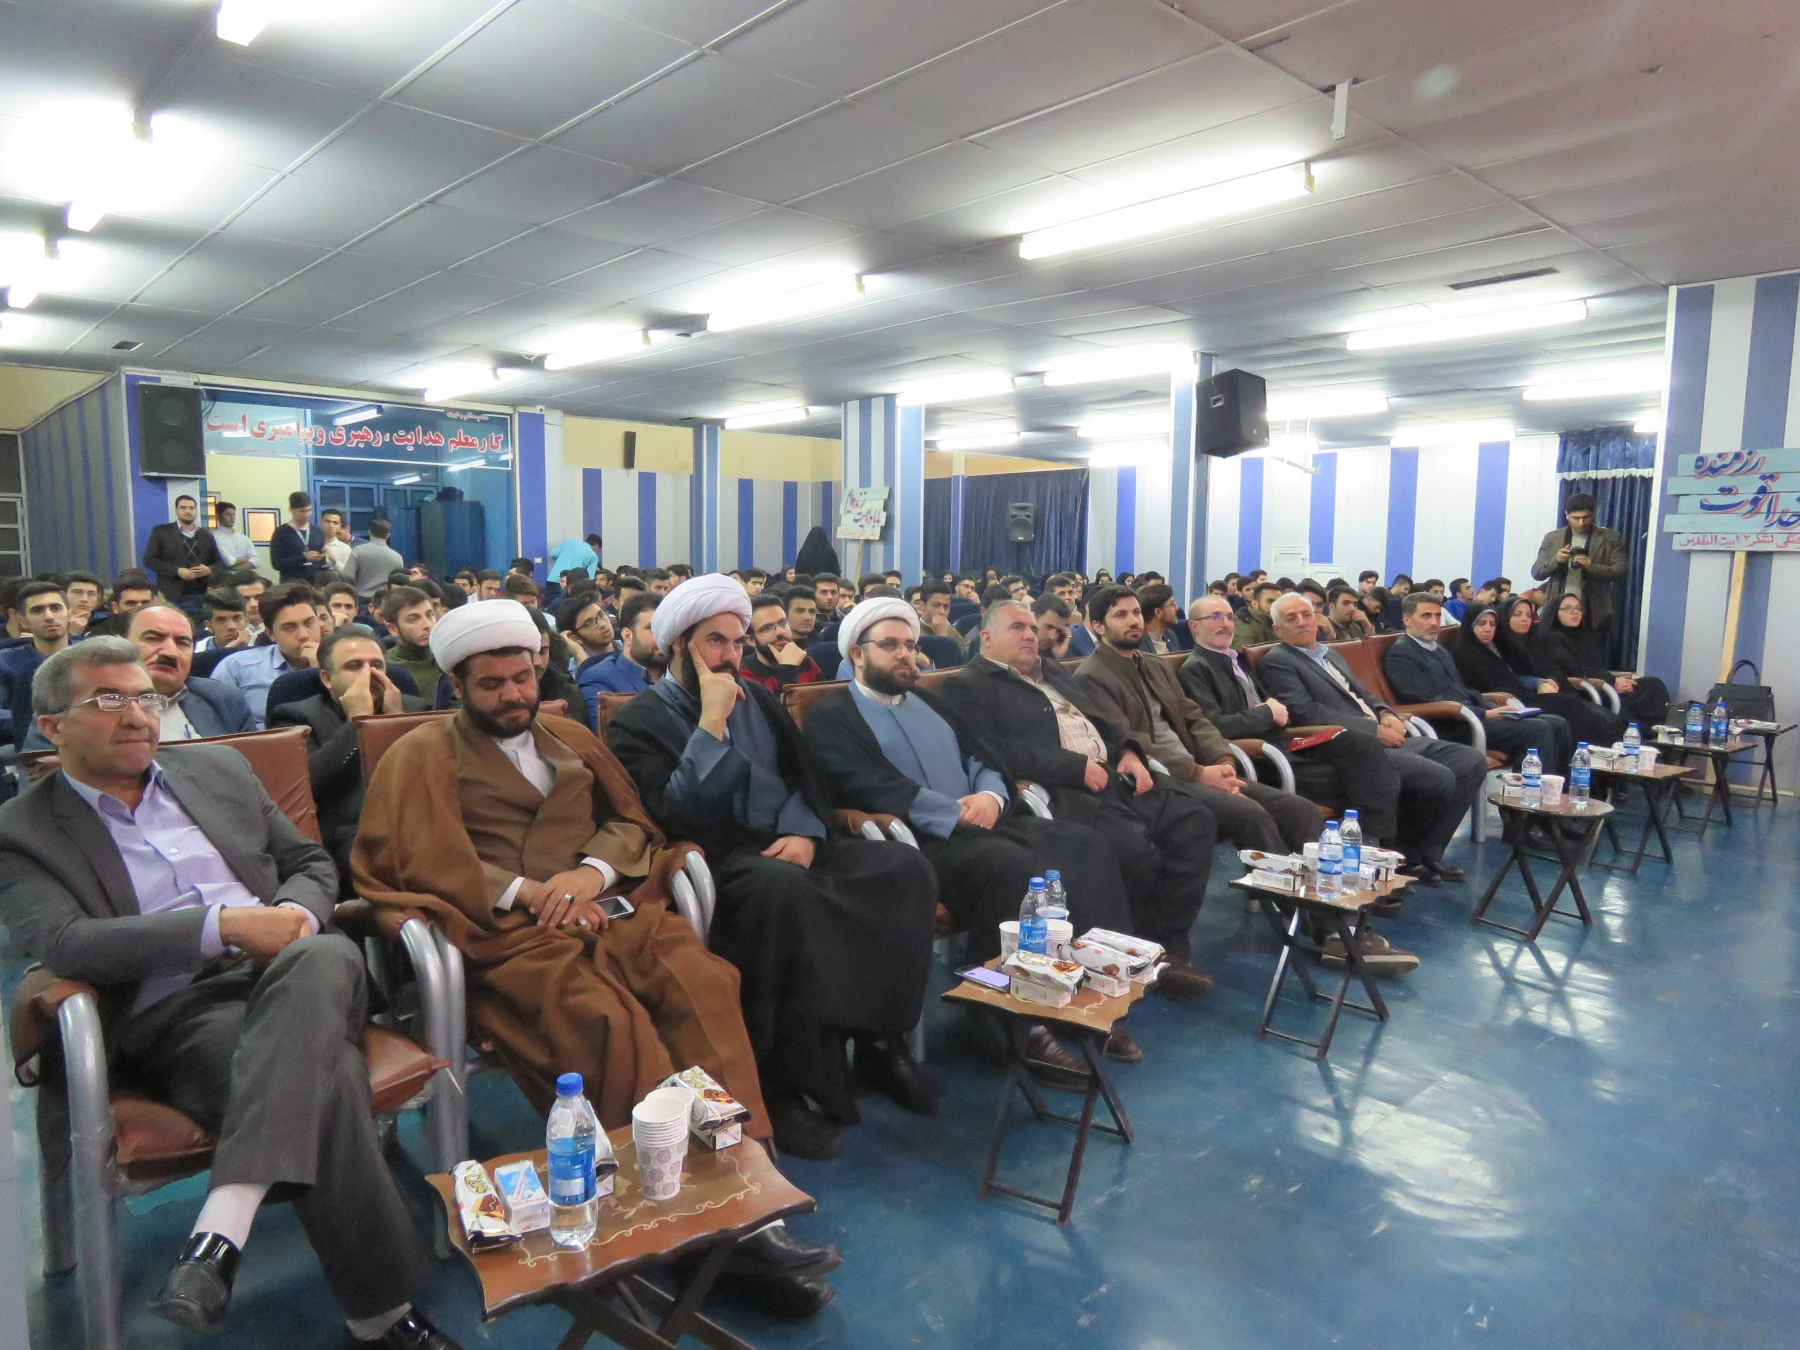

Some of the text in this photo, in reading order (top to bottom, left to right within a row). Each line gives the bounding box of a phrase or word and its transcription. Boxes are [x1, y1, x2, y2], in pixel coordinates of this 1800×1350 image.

[206, 413, 247, 432] است
[329, 425, 382, 448] رهبری
[448, 428, 479, 453] معلم
[477, 432, 504, 453] کار
[1694, 450, 1767, 479] رزمنده
[1699, 473, 1780, 519] قوت
